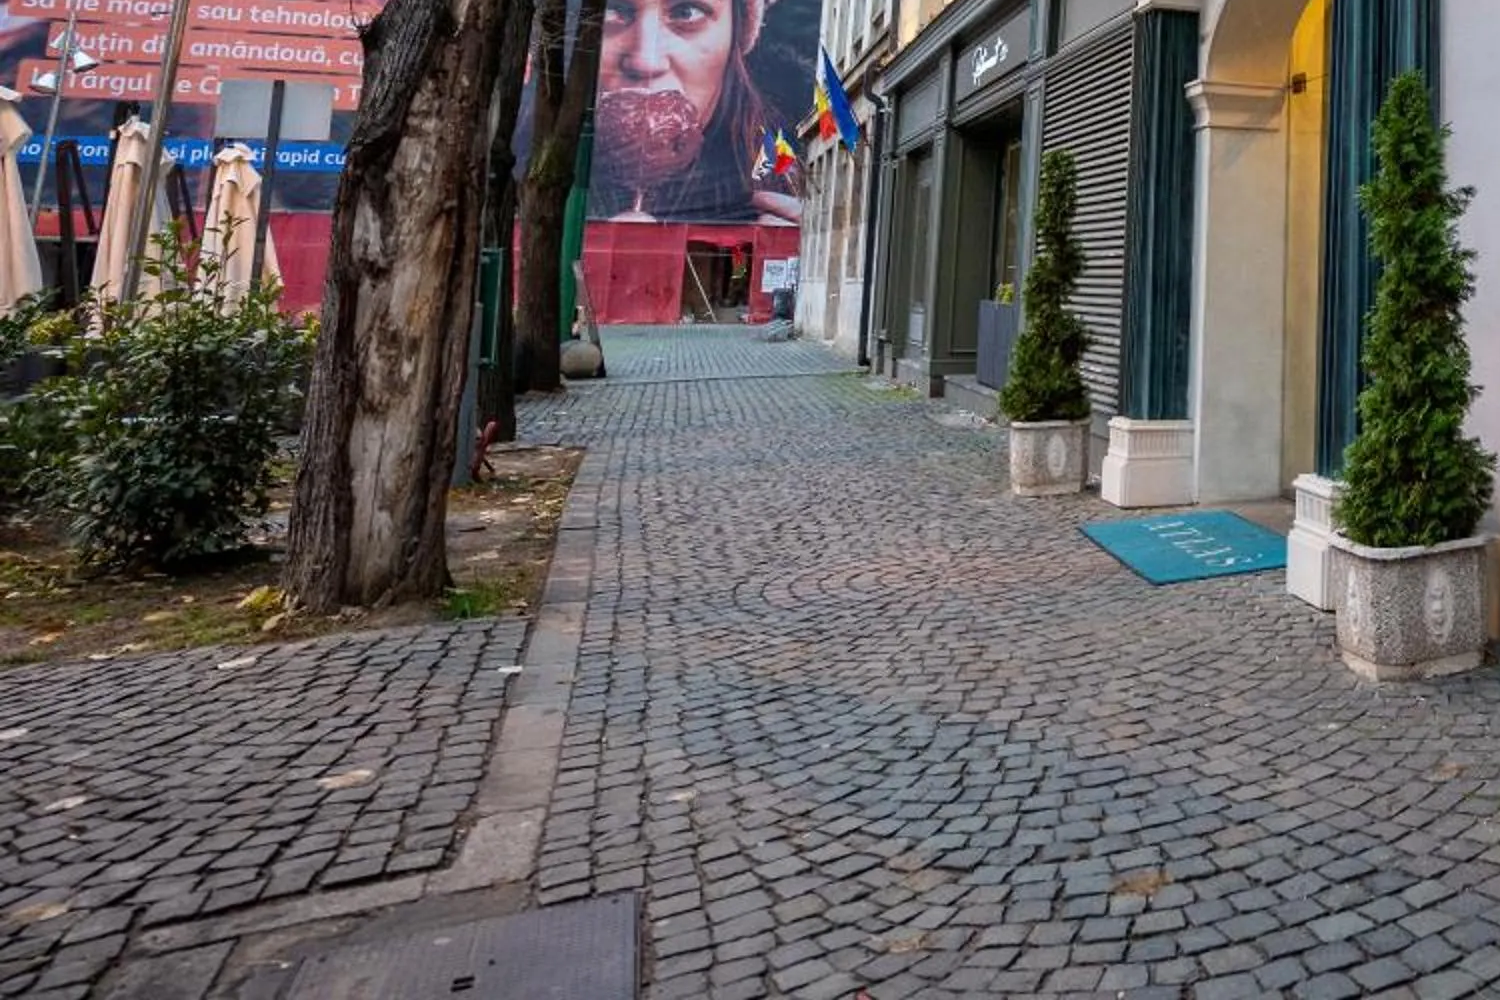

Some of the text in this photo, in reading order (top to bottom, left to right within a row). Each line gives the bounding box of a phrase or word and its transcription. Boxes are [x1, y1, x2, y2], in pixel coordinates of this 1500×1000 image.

[197, 5, 242, 22] sau
[250, 6, 373, 34] tehnologi
[74, 32, 133, 57] uțin
[142, 34, 168, 54] di
